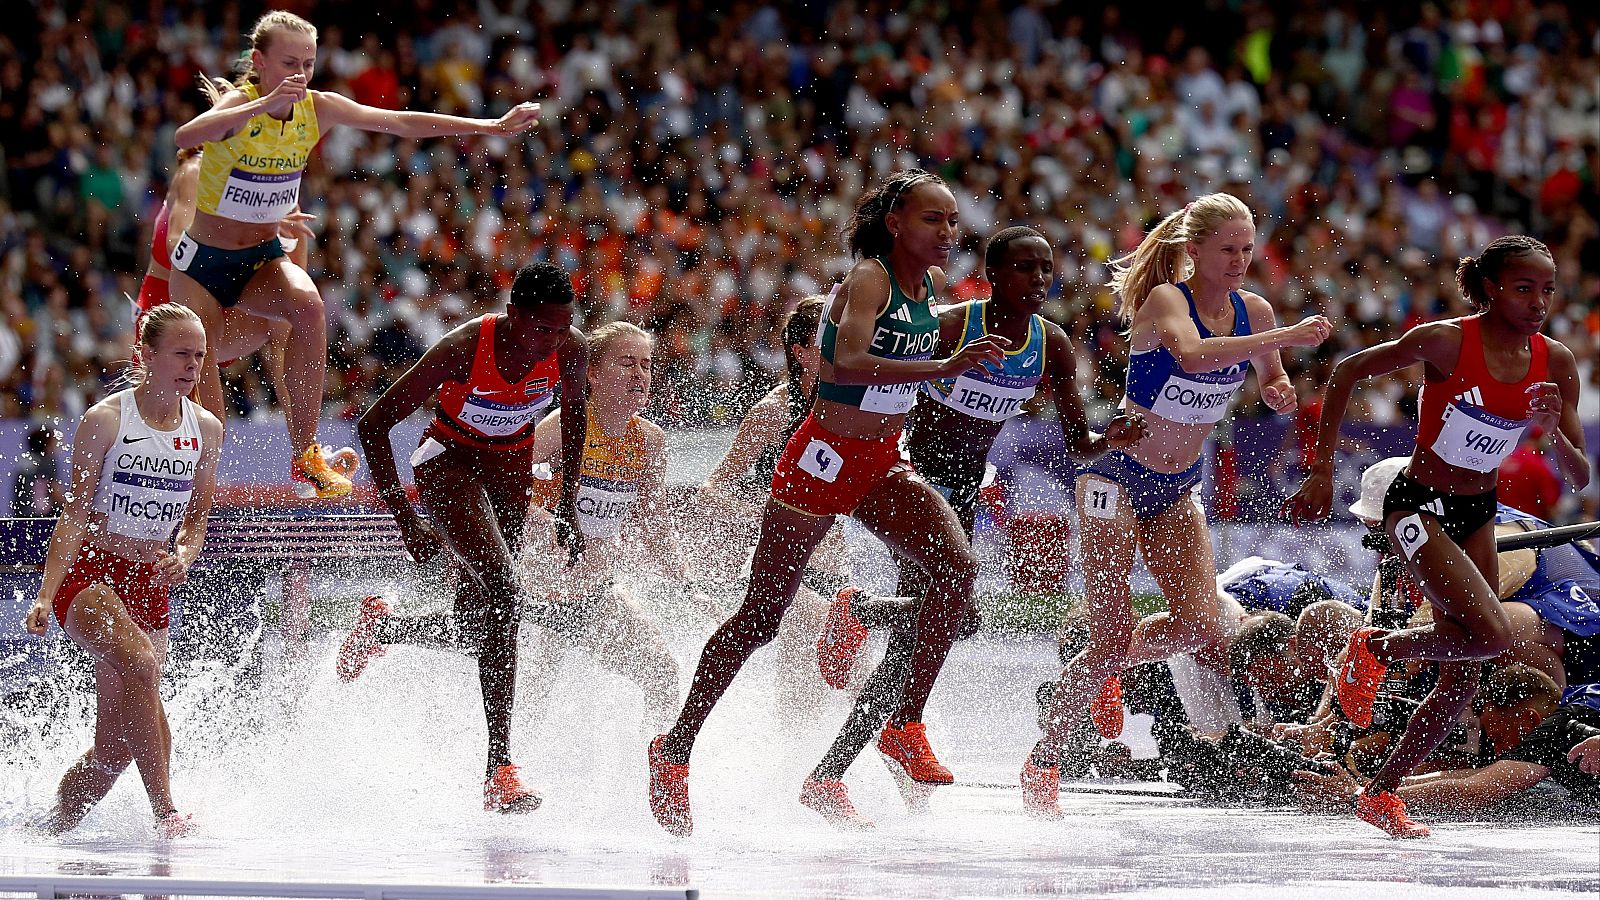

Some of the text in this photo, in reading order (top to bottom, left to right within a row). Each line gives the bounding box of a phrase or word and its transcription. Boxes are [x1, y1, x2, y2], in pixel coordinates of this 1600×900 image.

[174, 241, 188, 261] 5
[1195, 374, 1216, 382] PARIS
[1480, 413, 1502, 425] PARIS
[1465, 429, 1508, 455] YAVI
[118, 453, 193, 476] CANADA
[815, 448, 832, 473] 4
[137, 477, 160, 487] PARIS
[1092, 490, 1107, 509] 11
[1400, 523, 1420, 550] 10
